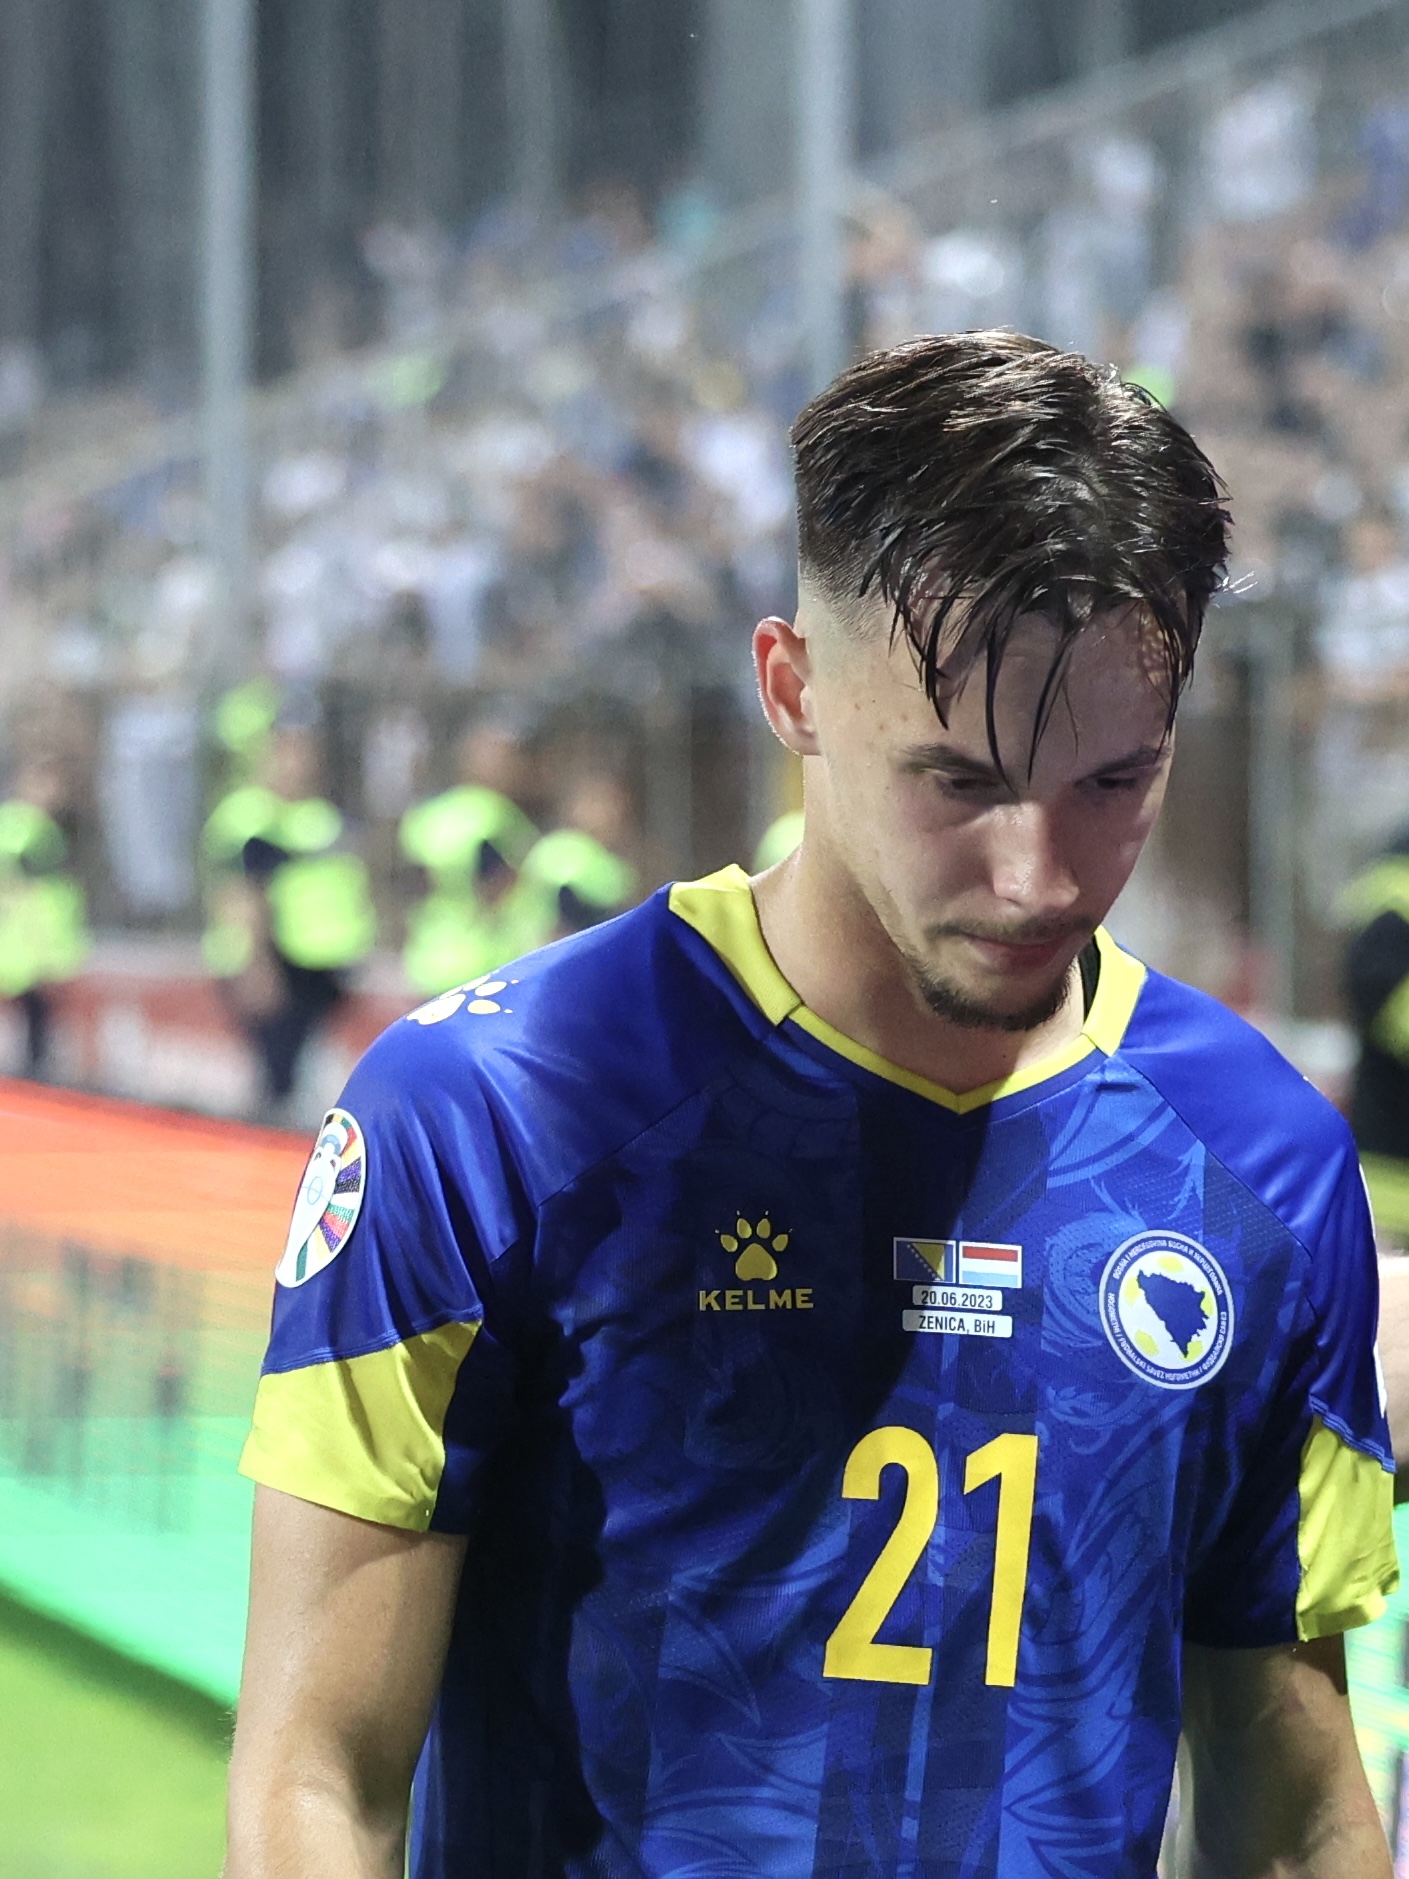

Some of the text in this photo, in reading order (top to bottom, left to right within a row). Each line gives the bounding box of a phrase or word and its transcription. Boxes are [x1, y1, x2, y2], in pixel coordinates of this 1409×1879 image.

[699, 1288, 814, 1311] KELME
[921, 1290, 993, 1309] 20.06.2023
[918, 1315, 996, 1334] ZENICA, BiH
[823, 1426, 1038, 1687] 21
